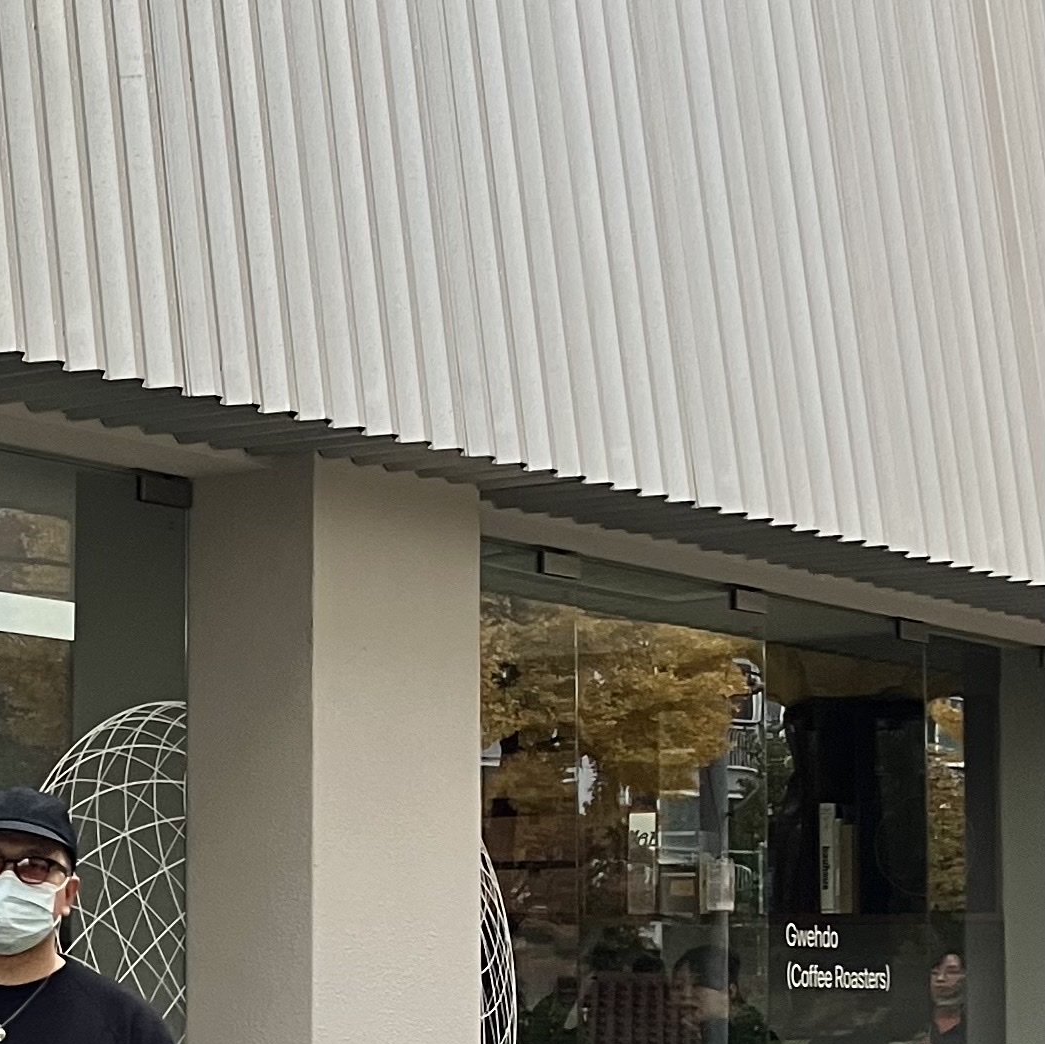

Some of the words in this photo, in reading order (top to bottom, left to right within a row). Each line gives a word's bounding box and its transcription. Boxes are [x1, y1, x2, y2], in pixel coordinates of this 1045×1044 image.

[785, 922, 839, 948] Gwehdo
[786, 961, 833, 990] (Coffee
[835, 963, 891, 992] Roasters)
